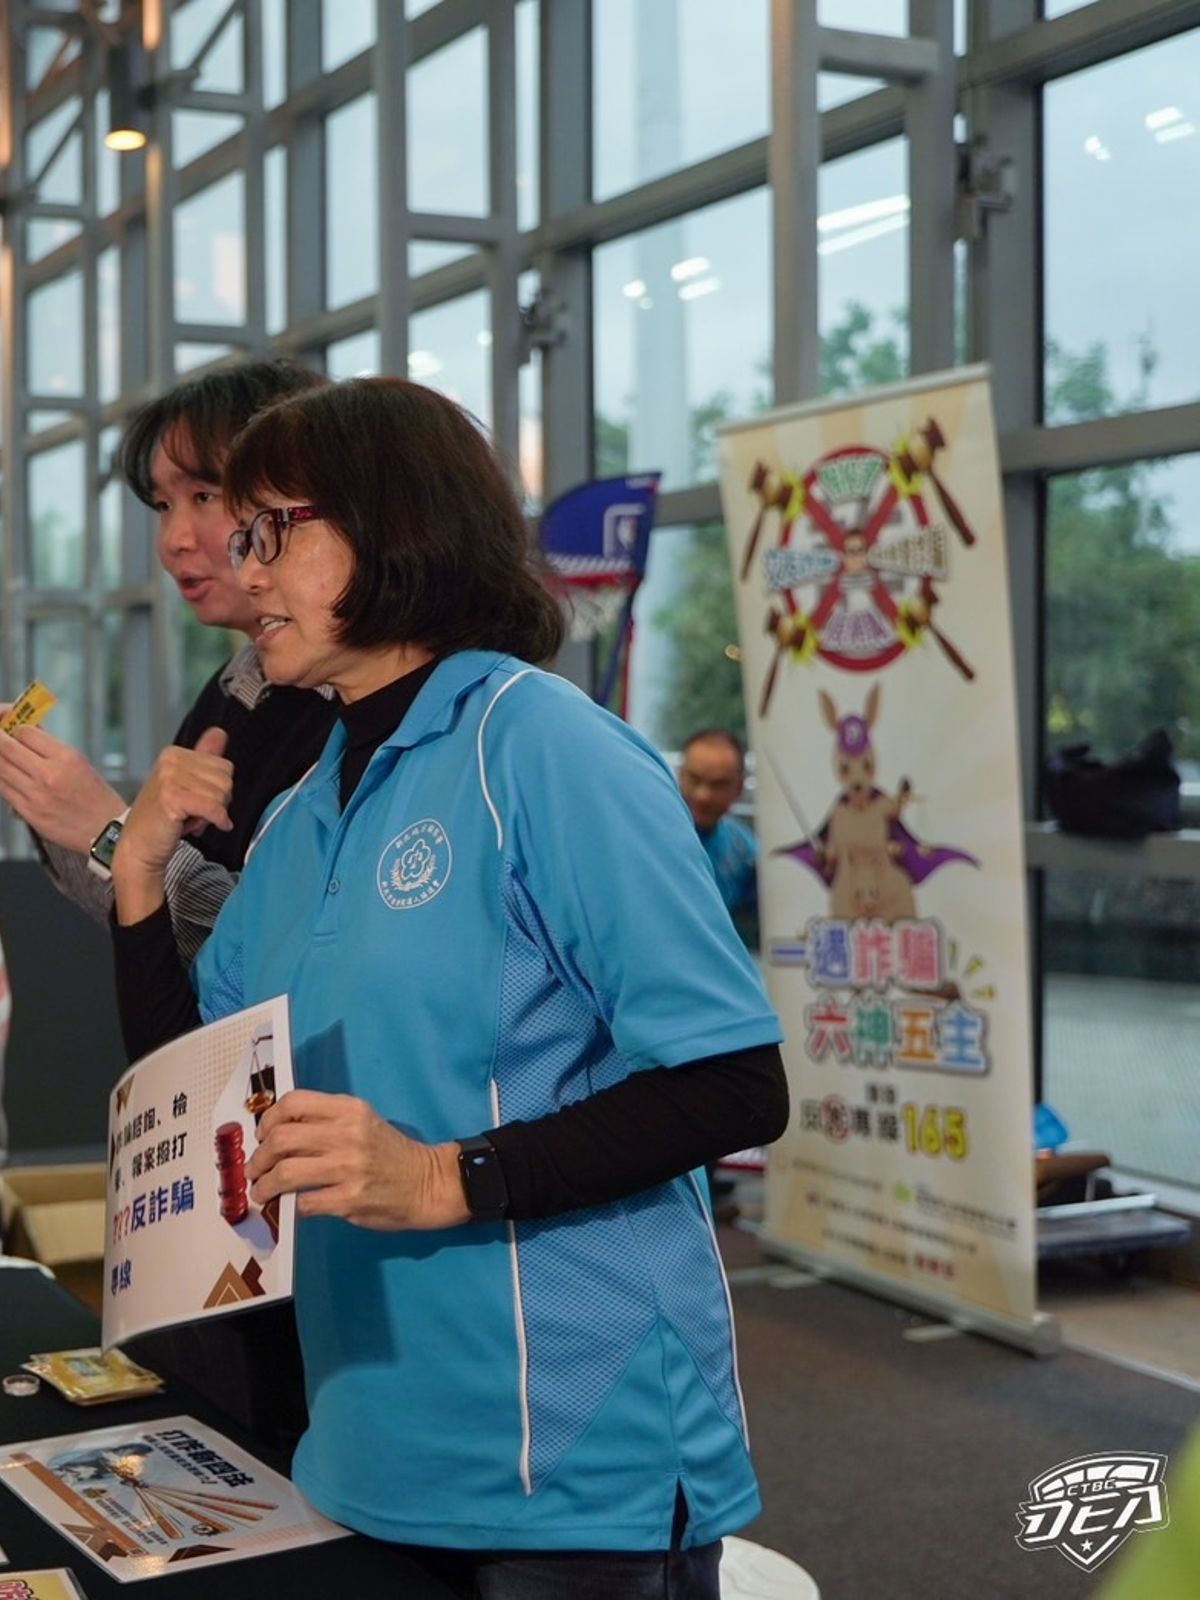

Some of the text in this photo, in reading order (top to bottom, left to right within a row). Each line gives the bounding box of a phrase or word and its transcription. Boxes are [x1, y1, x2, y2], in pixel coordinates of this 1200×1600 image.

[809, 999, 984, 1066] 六神五主
[902, 1103, 968, 1161] 165
